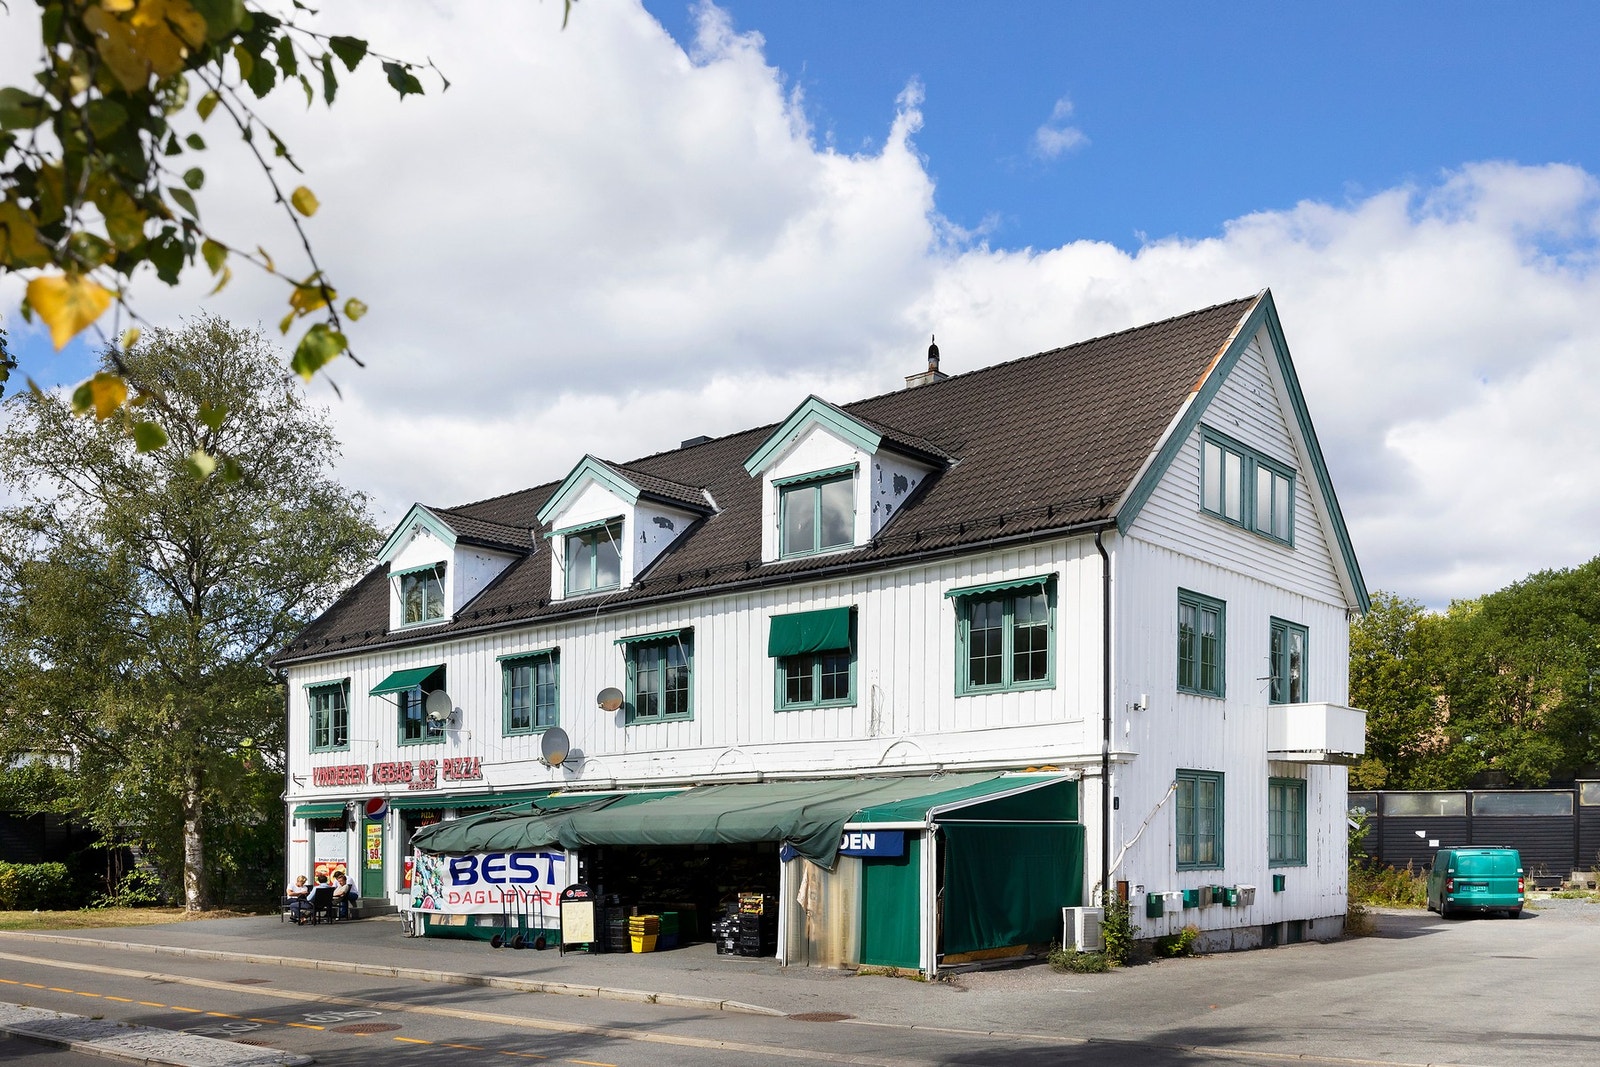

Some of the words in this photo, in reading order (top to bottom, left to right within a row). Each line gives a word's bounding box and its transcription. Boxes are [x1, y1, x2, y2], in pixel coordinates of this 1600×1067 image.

[313, 764, 366, 786] VINDEREN
[372, 761, 413, 784] KEBAB
[419, 760, 437, 780] OG
[443, 757, 482, 780] PIZZA
[449, 852, 565, 886] BEST
